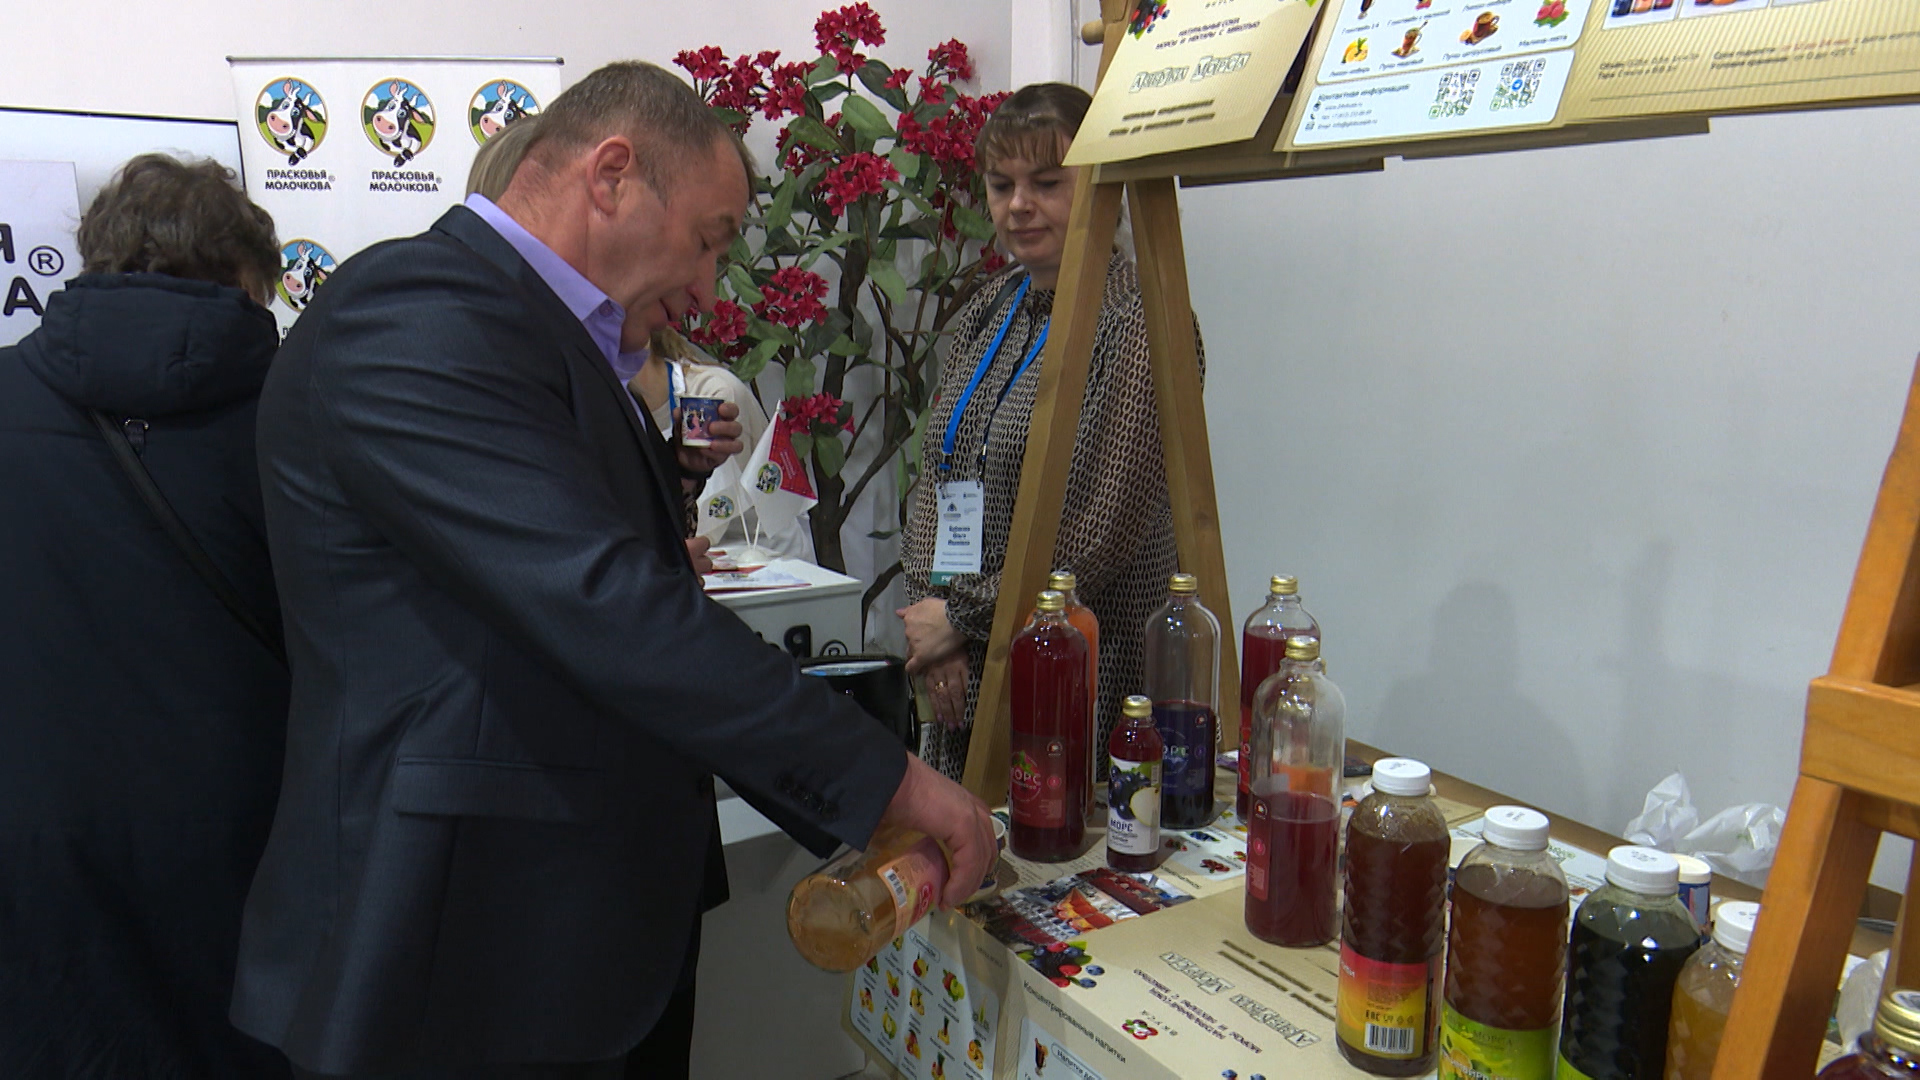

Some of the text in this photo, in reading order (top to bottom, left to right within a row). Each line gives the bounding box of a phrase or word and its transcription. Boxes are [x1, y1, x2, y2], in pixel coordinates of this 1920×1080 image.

[266, 169, 328, 180] ПРАСКОВЬЯ
[371, 170, 435, 181] ПРАСКОВЬЯ
[265, 181, 332, 191] МОЛОЧКОВА
[369, 182, 439, 193] МОЛОЧКОВА
[1110, 817, 1134, 832] МОРС
[1094, 1035, 1127, 1064] напитки
